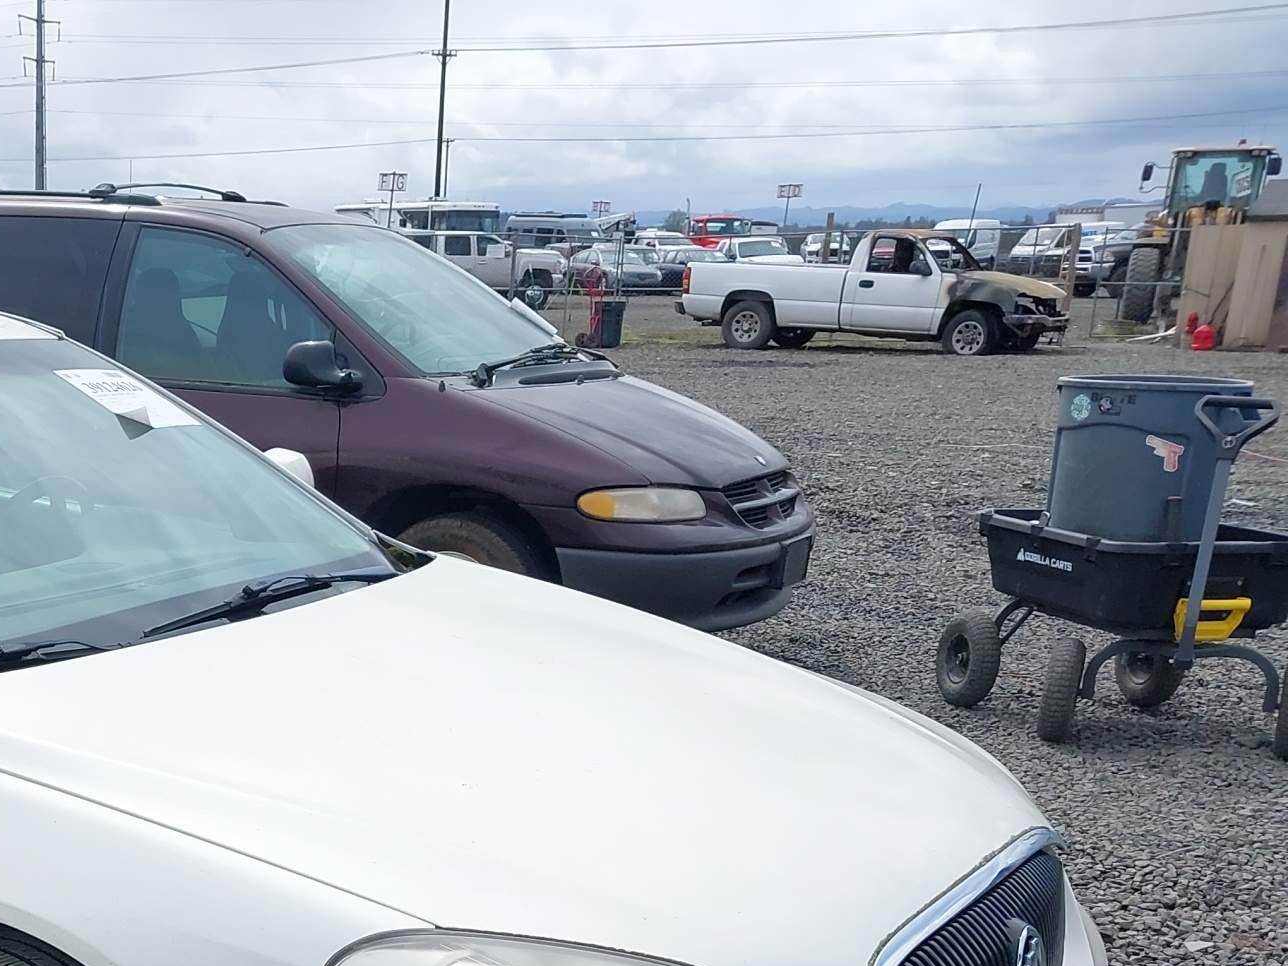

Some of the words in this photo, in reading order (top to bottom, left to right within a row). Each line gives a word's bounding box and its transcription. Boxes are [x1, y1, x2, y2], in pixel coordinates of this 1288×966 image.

[396, 174, 405, 190] G
[1024, 551, 1050, 567] GORILLA
[1050, 558, 1073, 572] CARTS
